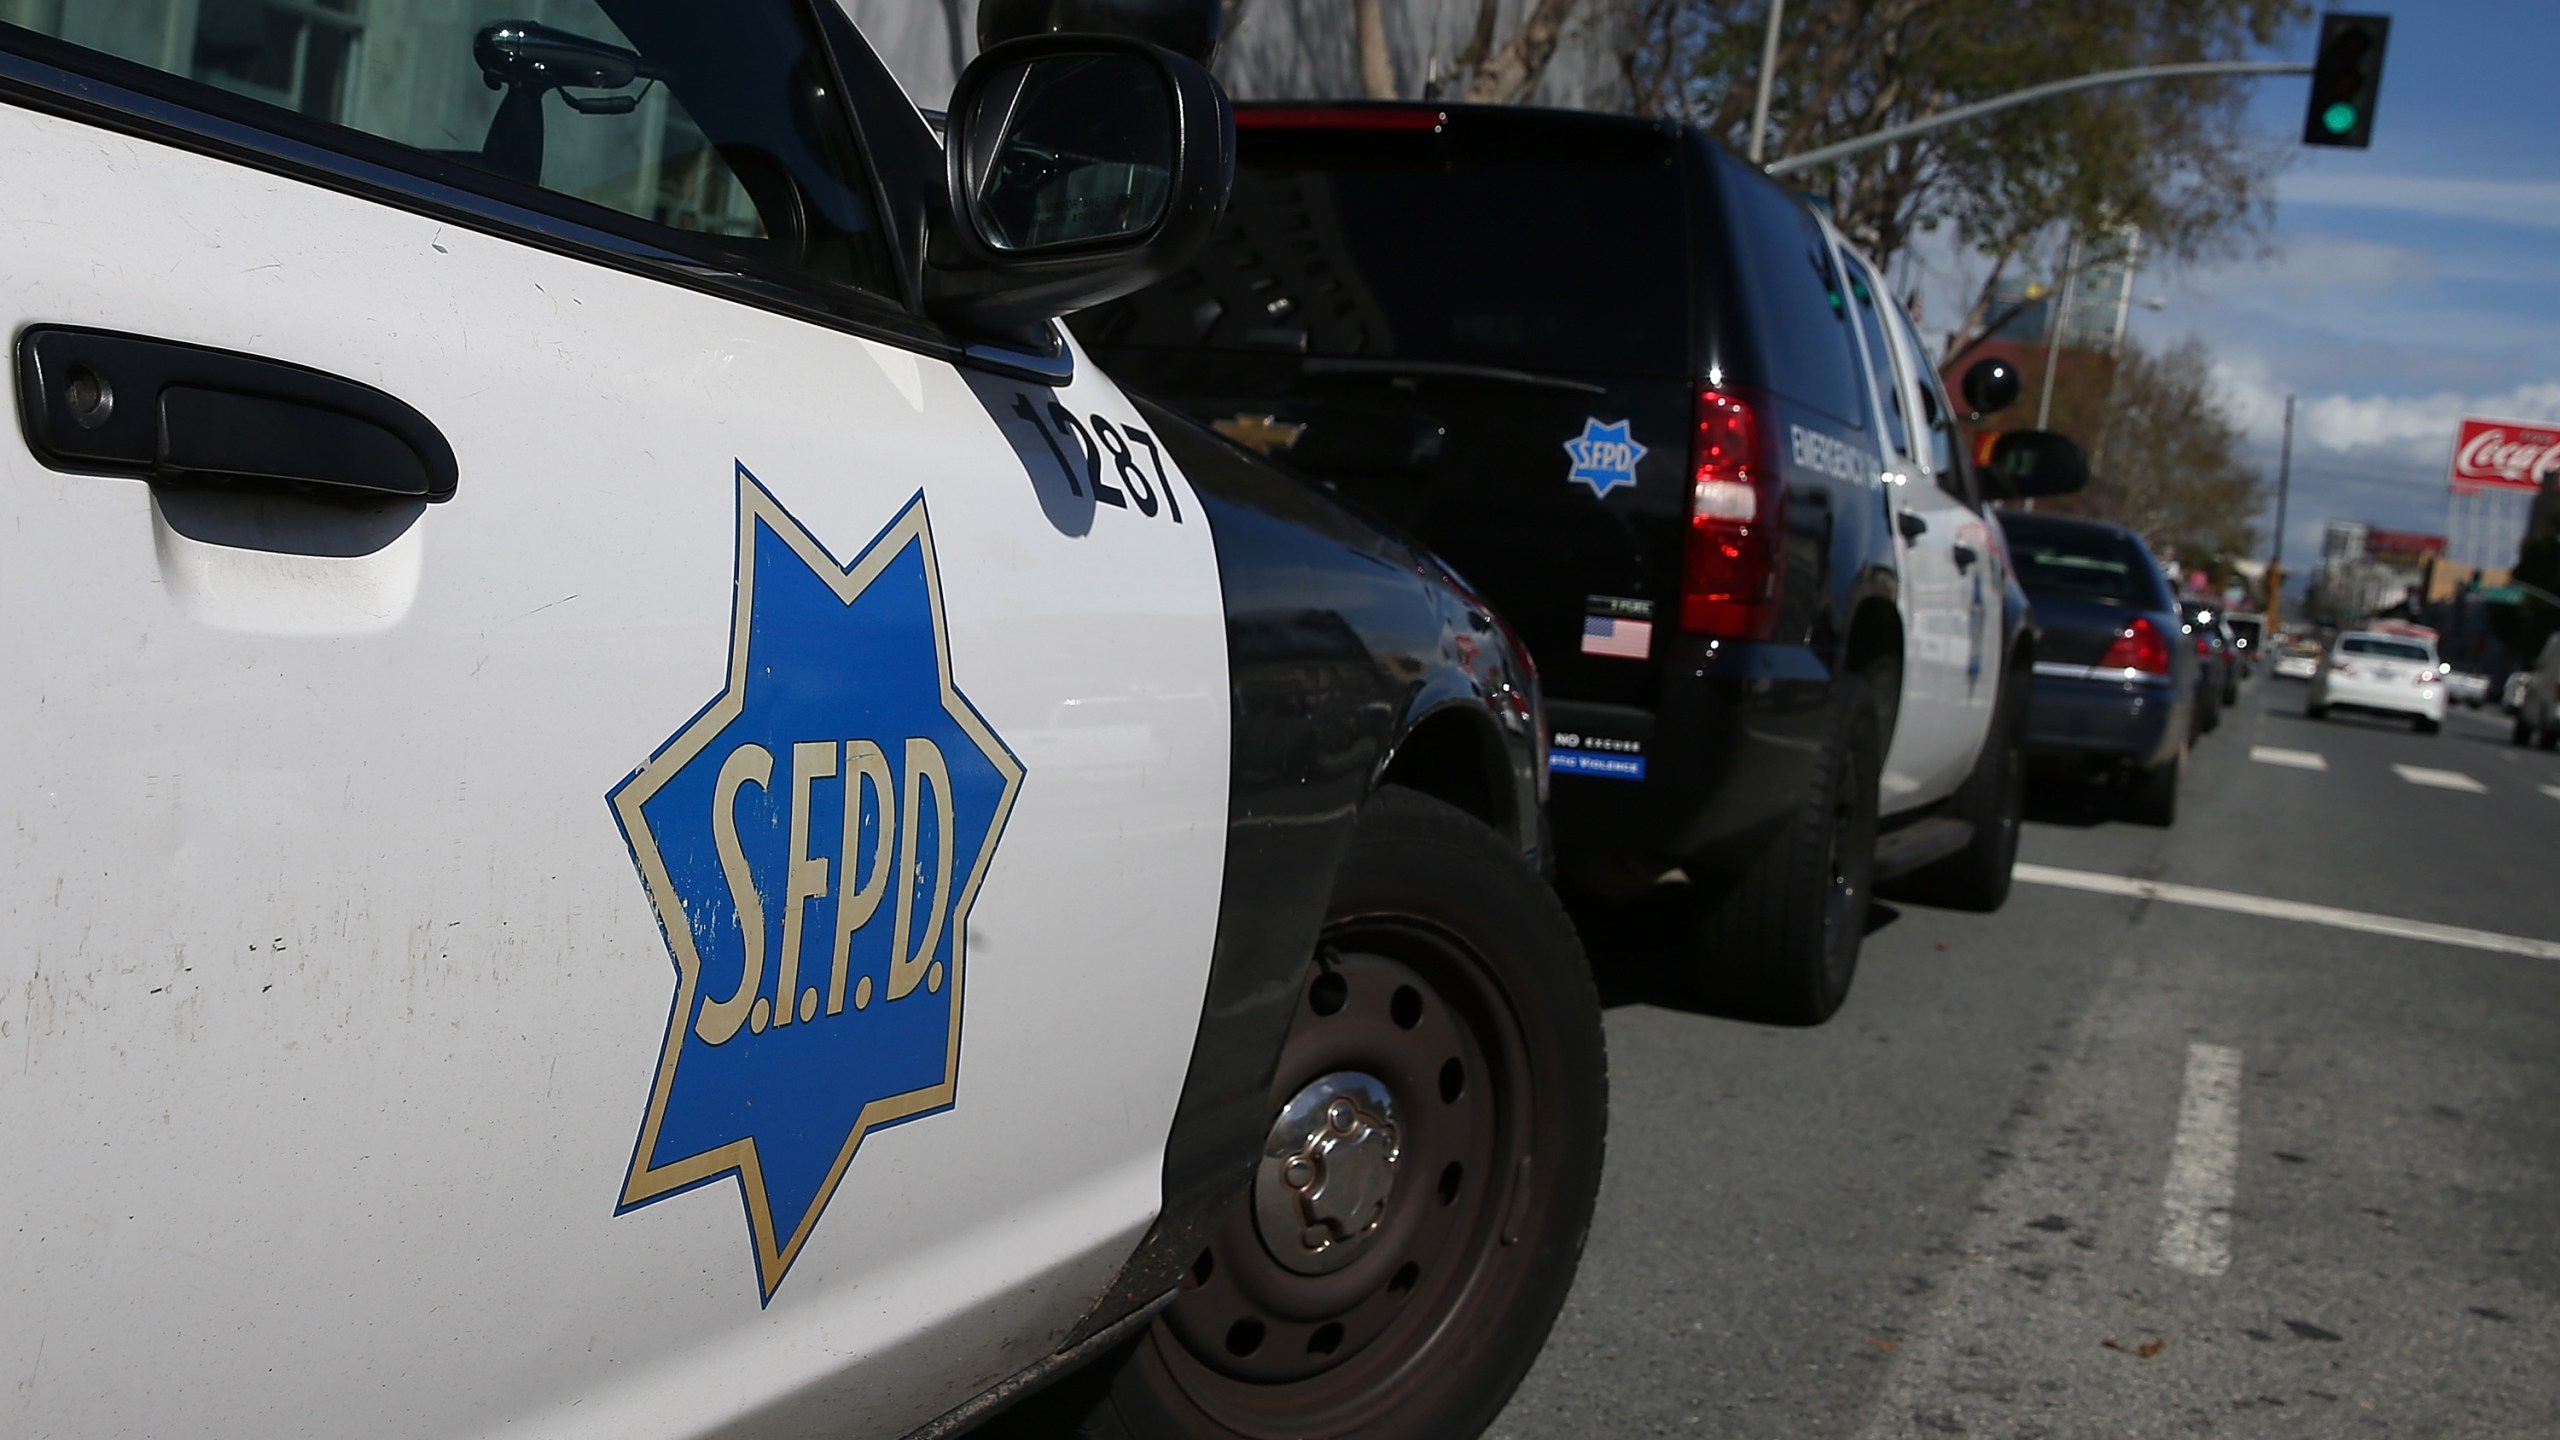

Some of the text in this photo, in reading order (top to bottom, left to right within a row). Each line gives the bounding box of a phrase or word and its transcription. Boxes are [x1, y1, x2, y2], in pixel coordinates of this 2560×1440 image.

[1011, 392, 1183, 525] 1287
[1554, 732, 1580, 748] NO
[694, 737, 954, 1046] S.F.P.D.
